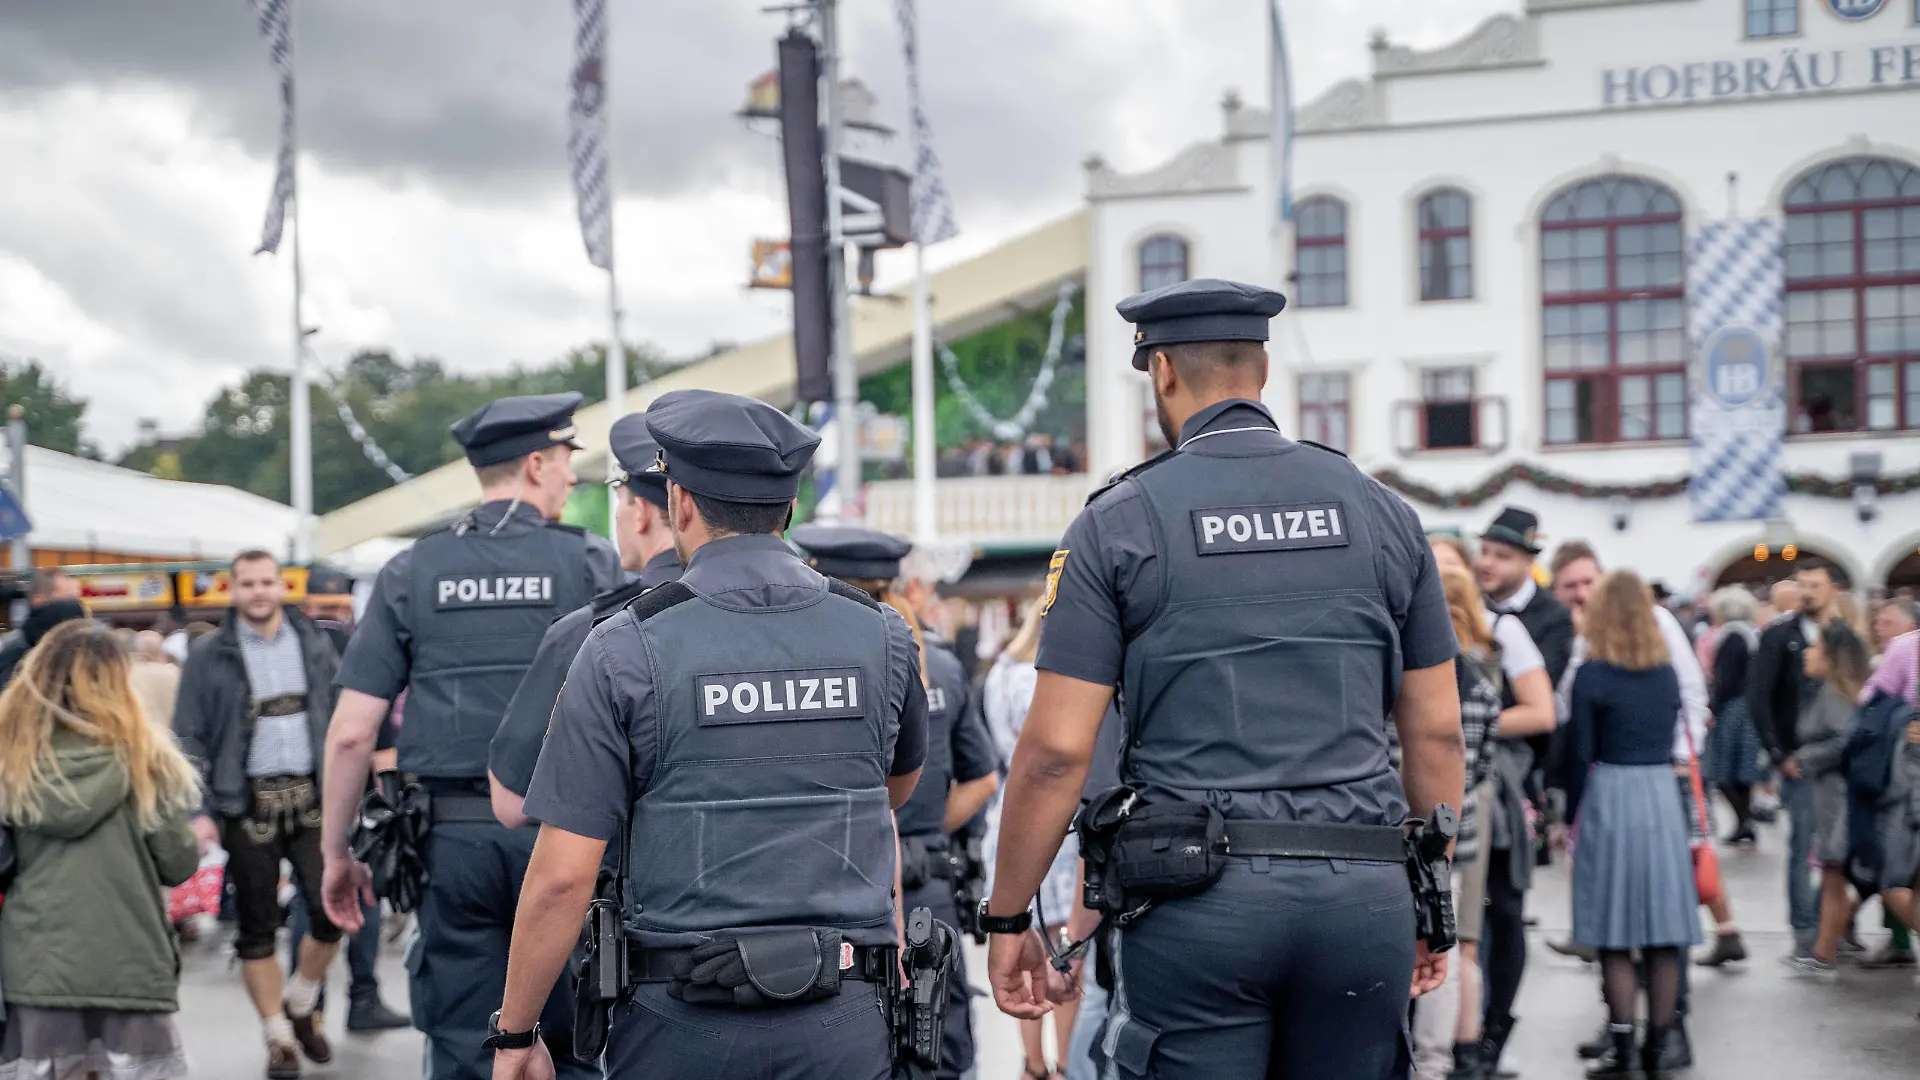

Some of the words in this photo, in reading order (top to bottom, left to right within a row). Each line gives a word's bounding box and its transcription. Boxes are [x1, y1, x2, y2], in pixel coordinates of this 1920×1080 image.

[1602, 47, 1845, 104] HOFBRÄU
[1201, 508, 1342, 544] POLIZEI
[438, 576, 552, 604] POLIZEI
[704, 676, 858, 716] POLIZEI
